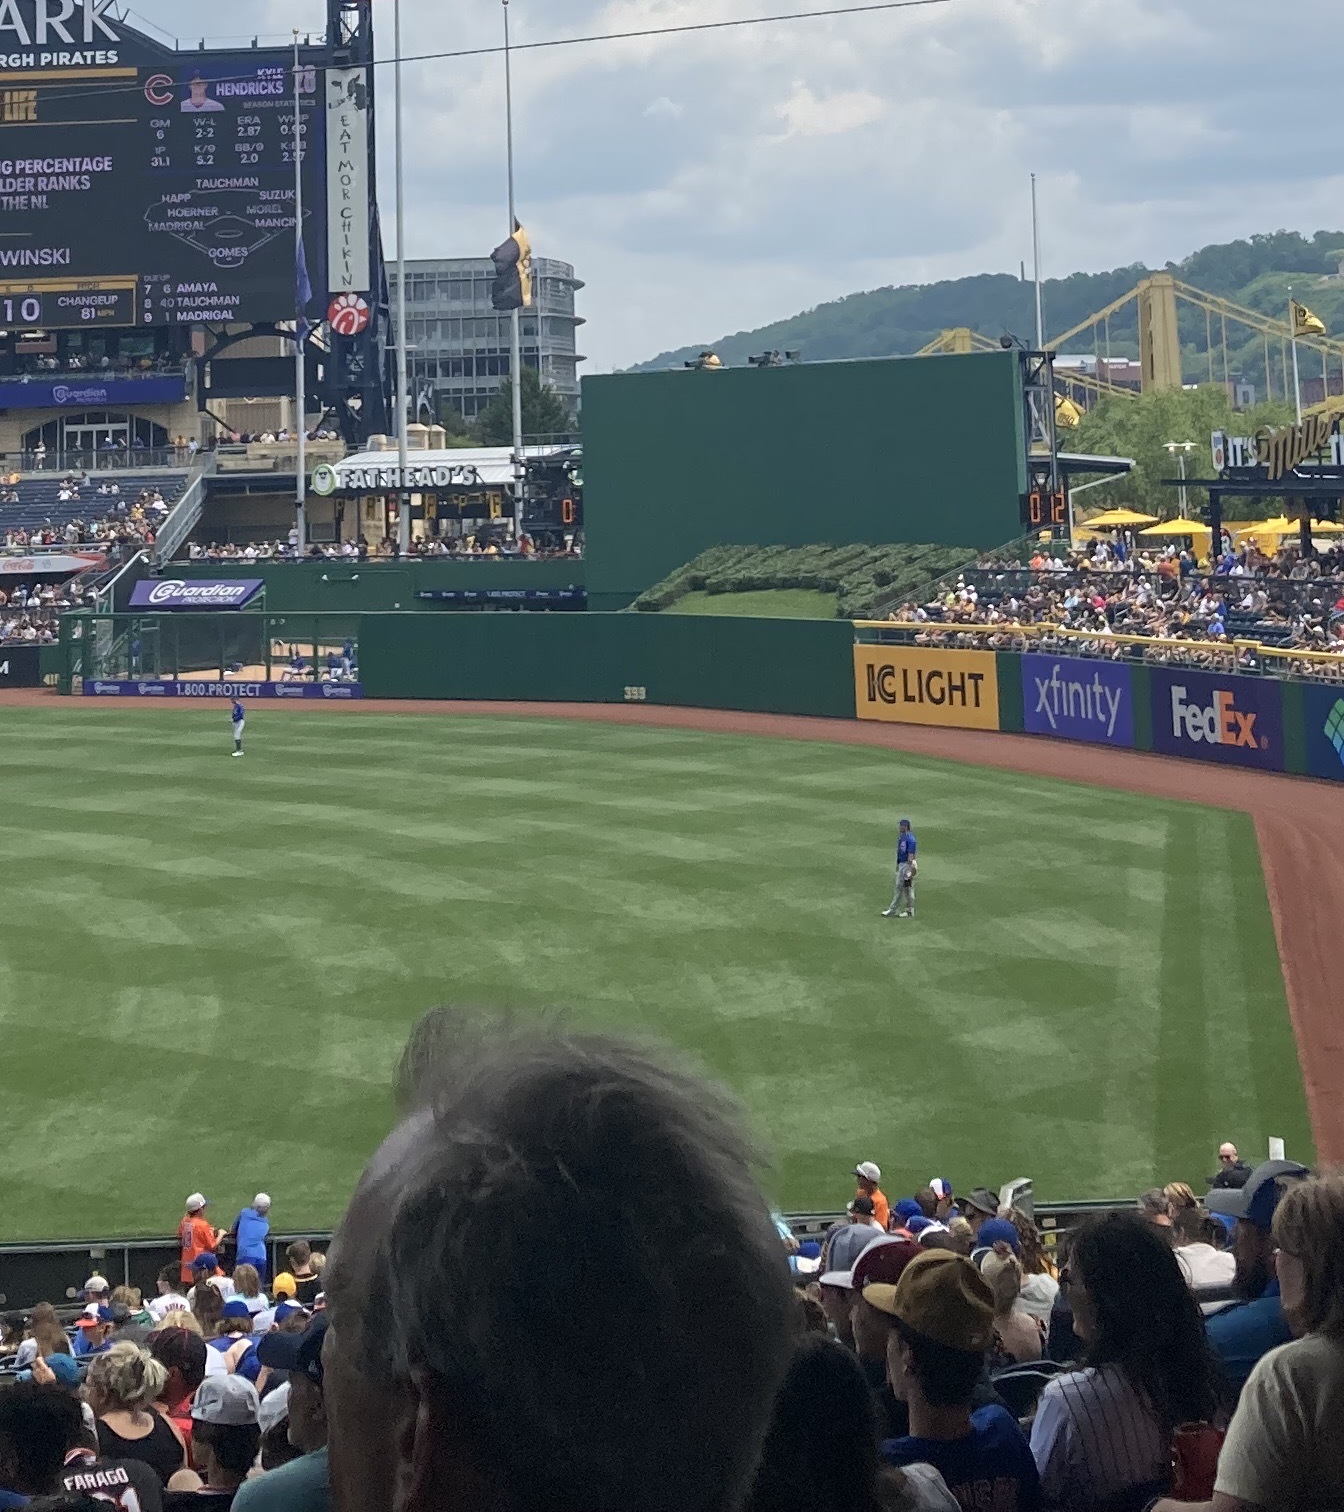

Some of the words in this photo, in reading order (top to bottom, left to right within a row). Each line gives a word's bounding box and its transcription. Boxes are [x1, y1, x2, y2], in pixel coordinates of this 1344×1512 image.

[39, 50, 119, 67] PIRATES
[144, 74, 174, 106] C
[216, 80, 284, 97] HENDRICKS
[5, 90, 38, 121] LIFE
[237, 116, 262, 125] ERA
[157, 131, 164, 140] 6
[196, 129, 214, 138] 2-2
[237, 127, 261, 137] 2.87
[339, 115, 351, 154] EAT
[15, 156, 113, 175] PERCENTAGE
[196, 155, 215, 165] 5.2
[241, 153, 259, 163] 2.0
[37, 175, 91, 192] RANKS
[196, 177, 259, 189] TAUCHMAN
[338, 160, 355, 200] MOR
[1, 195, 29, 211] THE
[31, 194, 49, 209] NL
[161, 193, 191, 203] HAPP
[167, 206, 219, 218] HOERNER
[246, 204, 283, 215] MOREL
[148, 221, 207, 232] MADRIGAL
[208, 247, 249, 258] GOMES
[340, 207, 353, 286] CHIKIN
[144, 284, 152, 294] 7
[163, 284, 171, 294] 6
[176, 282, 218, 293] AMAYA
[57, 295, 119, 306] CHANGEUP
[144, 298, 152, 309] 8
[160, 298, 175, 308] 40
[177, 295, 240, 307] TAUCHMAN
[81, 308, 96, 320] 81
[144, 313, 153, 323] 9
[176, 310, 234, 321] MADRIGAL
[53, 385, 107, 403] Guardian
[1227, 437, 1257, 467] IT'S
[1256, 412, 1344, 480] Miller
[340, 468, 383, 489] FAT
[387, 464, 477, 488] HEAD'S
[1030, 494, 1040, 522] 0
[1051, 493, 1065, 523] 12
[148, 579, 246, 604] Guardian
[176, 682, 262, 697] 1.800.PROTECT
[867, 664, 897, 704] IC
[903, 668, 984, 708] LIGHT
[1035, 665, 1121, 738] xfinity
[1171, 684, 1258, 750] FedEx
[63, 1467, 130, 1491] FARAGO
